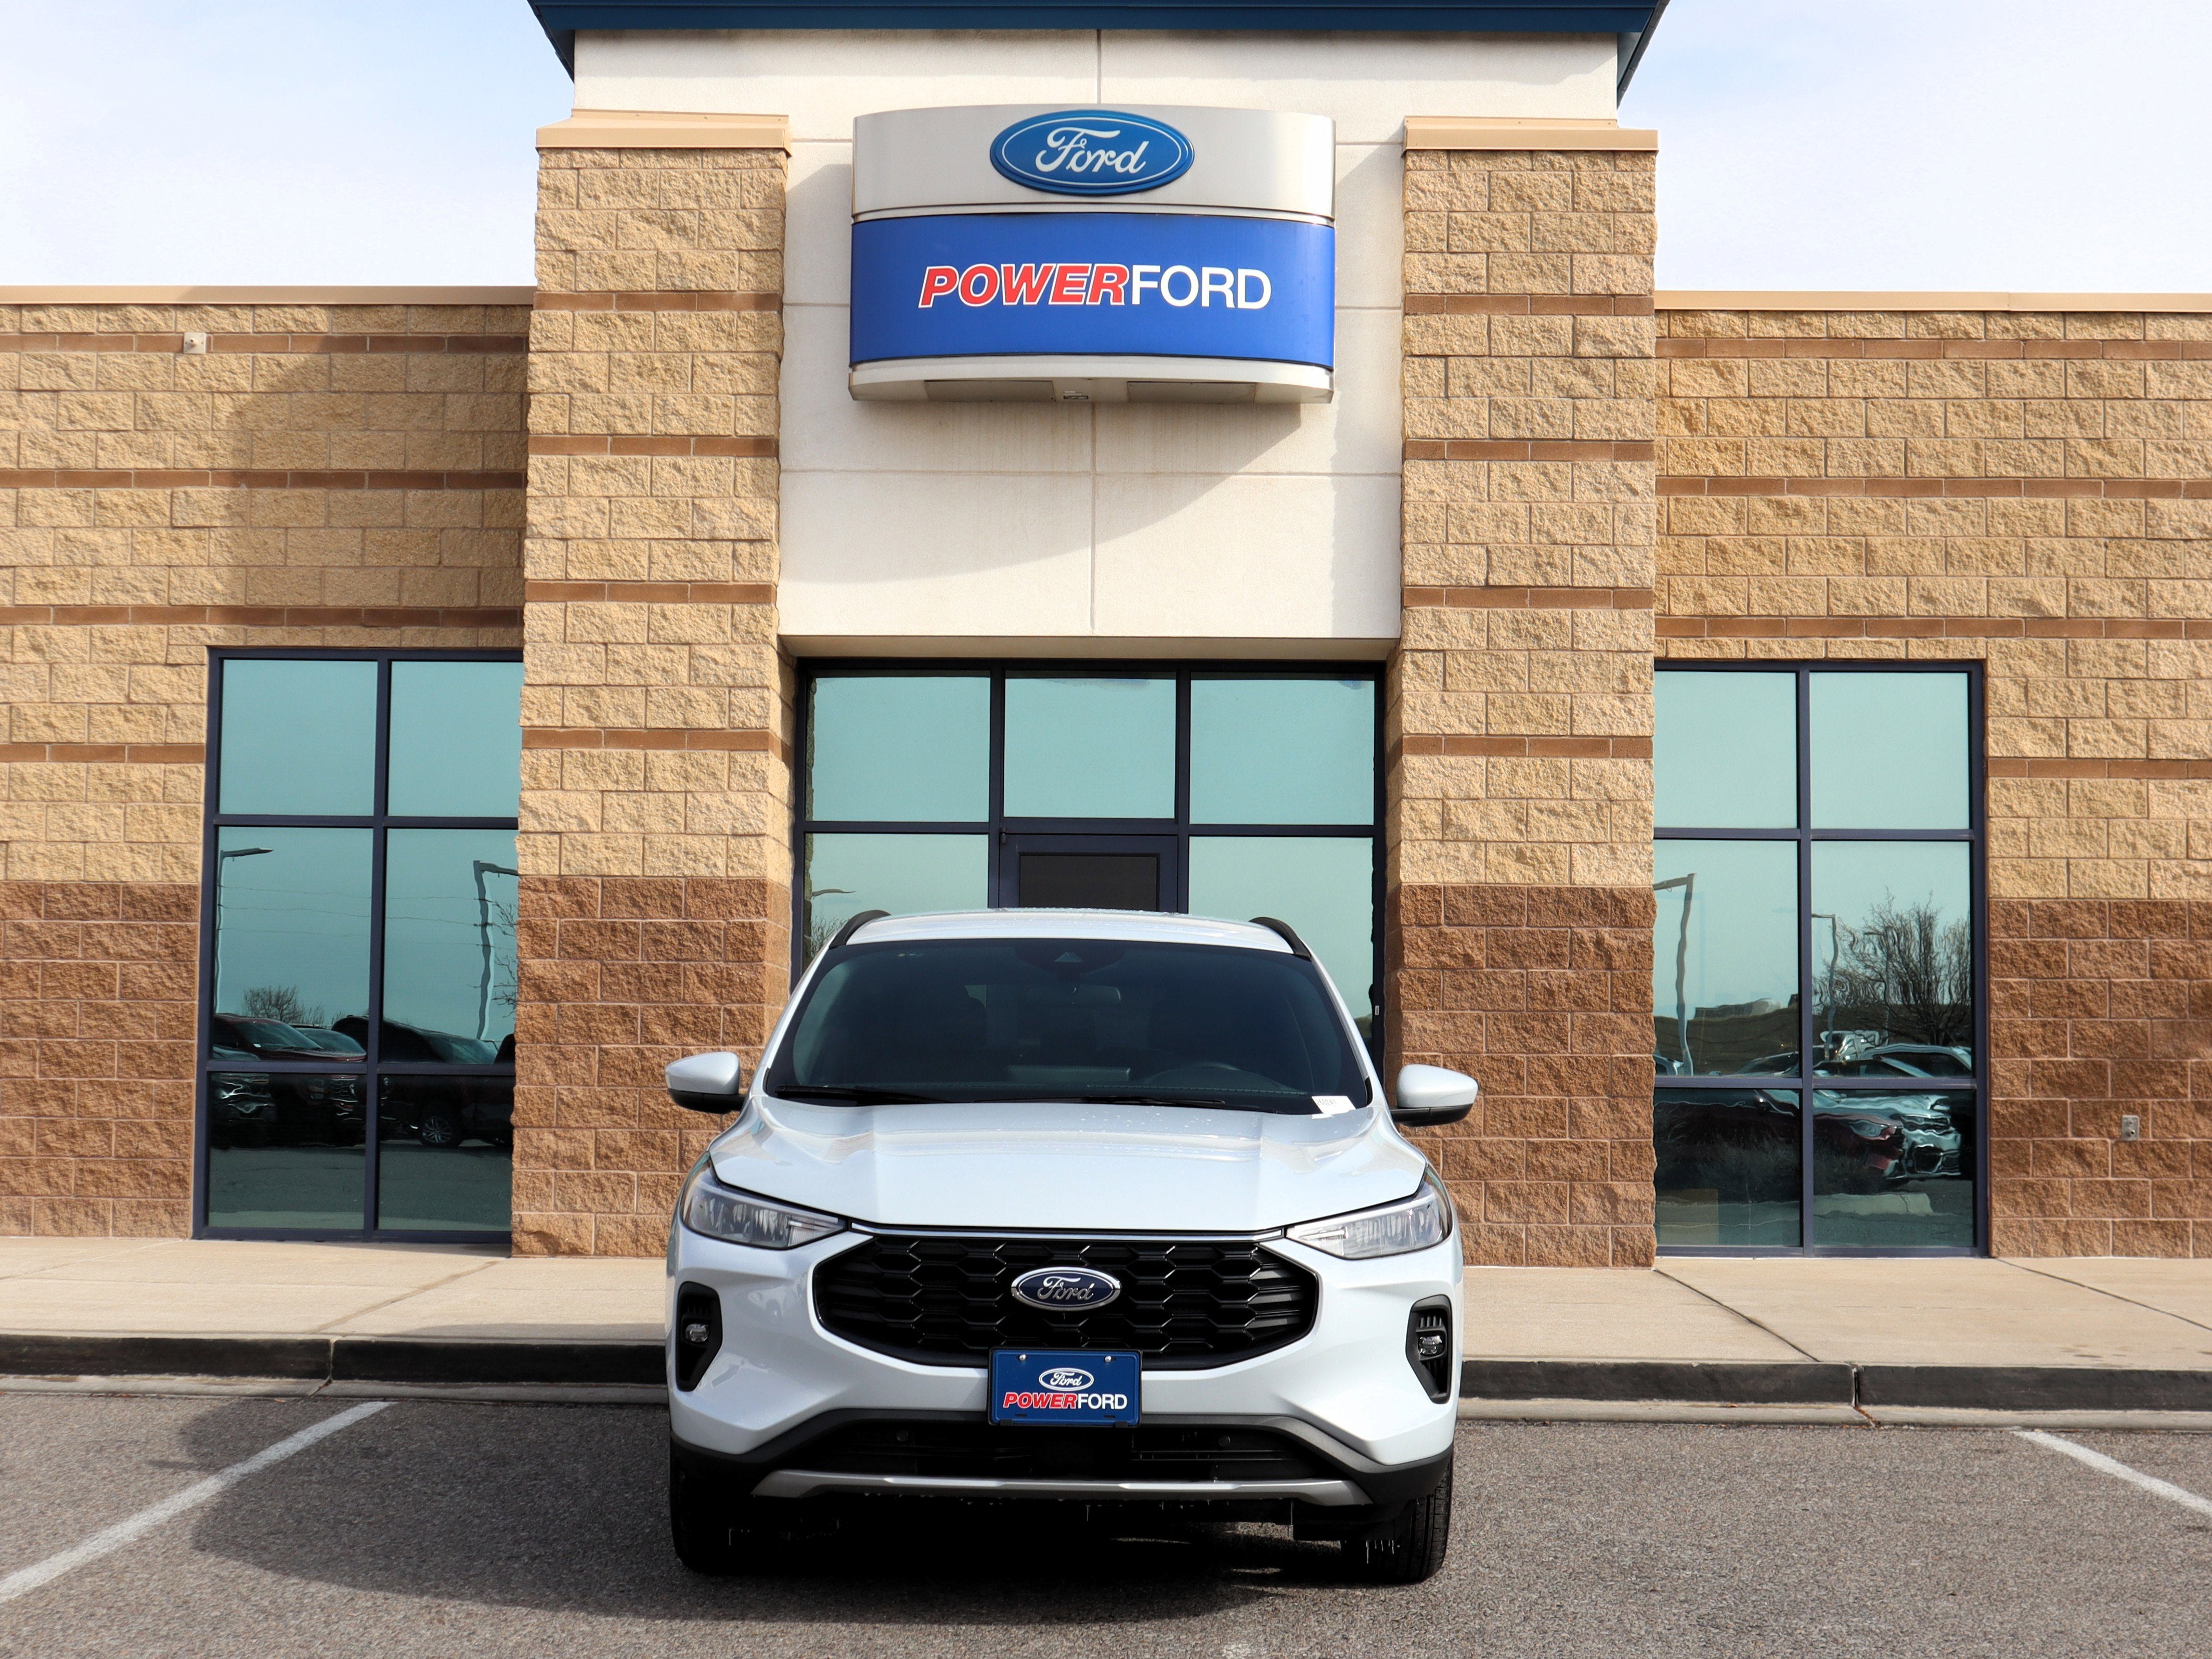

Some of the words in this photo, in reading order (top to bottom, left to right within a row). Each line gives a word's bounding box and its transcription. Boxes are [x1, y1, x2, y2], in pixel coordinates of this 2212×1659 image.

[1034, 126, 1149, 174] Ford
[918, 263, 1272, 309] POWERFORD
[1037, 1276, 1095, 1301] Ford
[1050, 1371, 1083, 1387] Ford
[1003, 1392, 1128, 1410] POWERFORD
